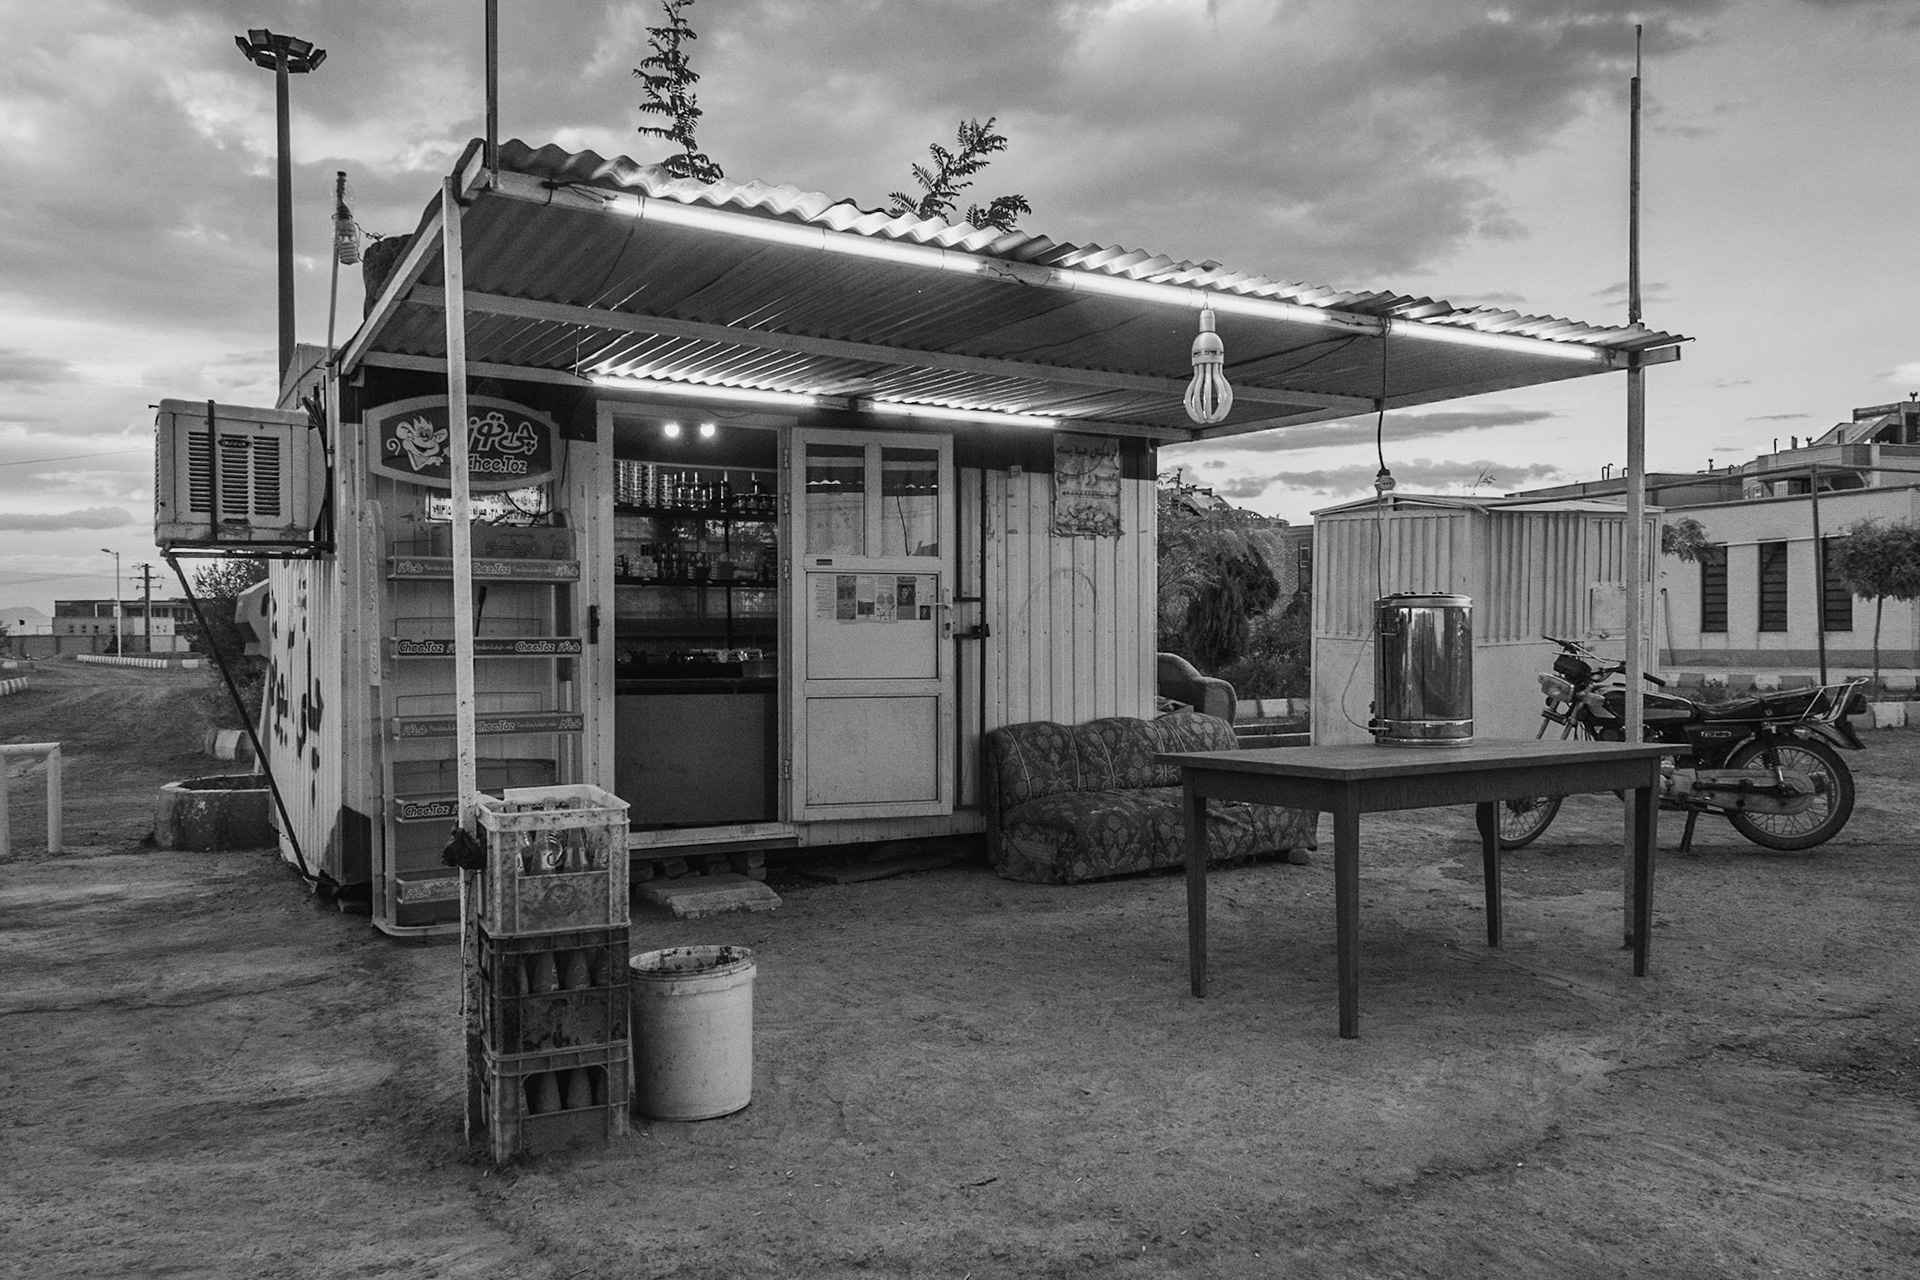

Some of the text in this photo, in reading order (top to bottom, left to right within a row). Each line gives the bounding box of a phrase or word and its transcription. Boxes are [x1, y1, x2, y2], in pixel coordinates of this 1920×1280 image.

[398, 641, 444, 654] Chee.Toz
[515, 641, 555, 653] Chee.Toz
[475, 720, 516, 733] Chee.Toz
[404, 803, 450, 818] Chee.Toz
